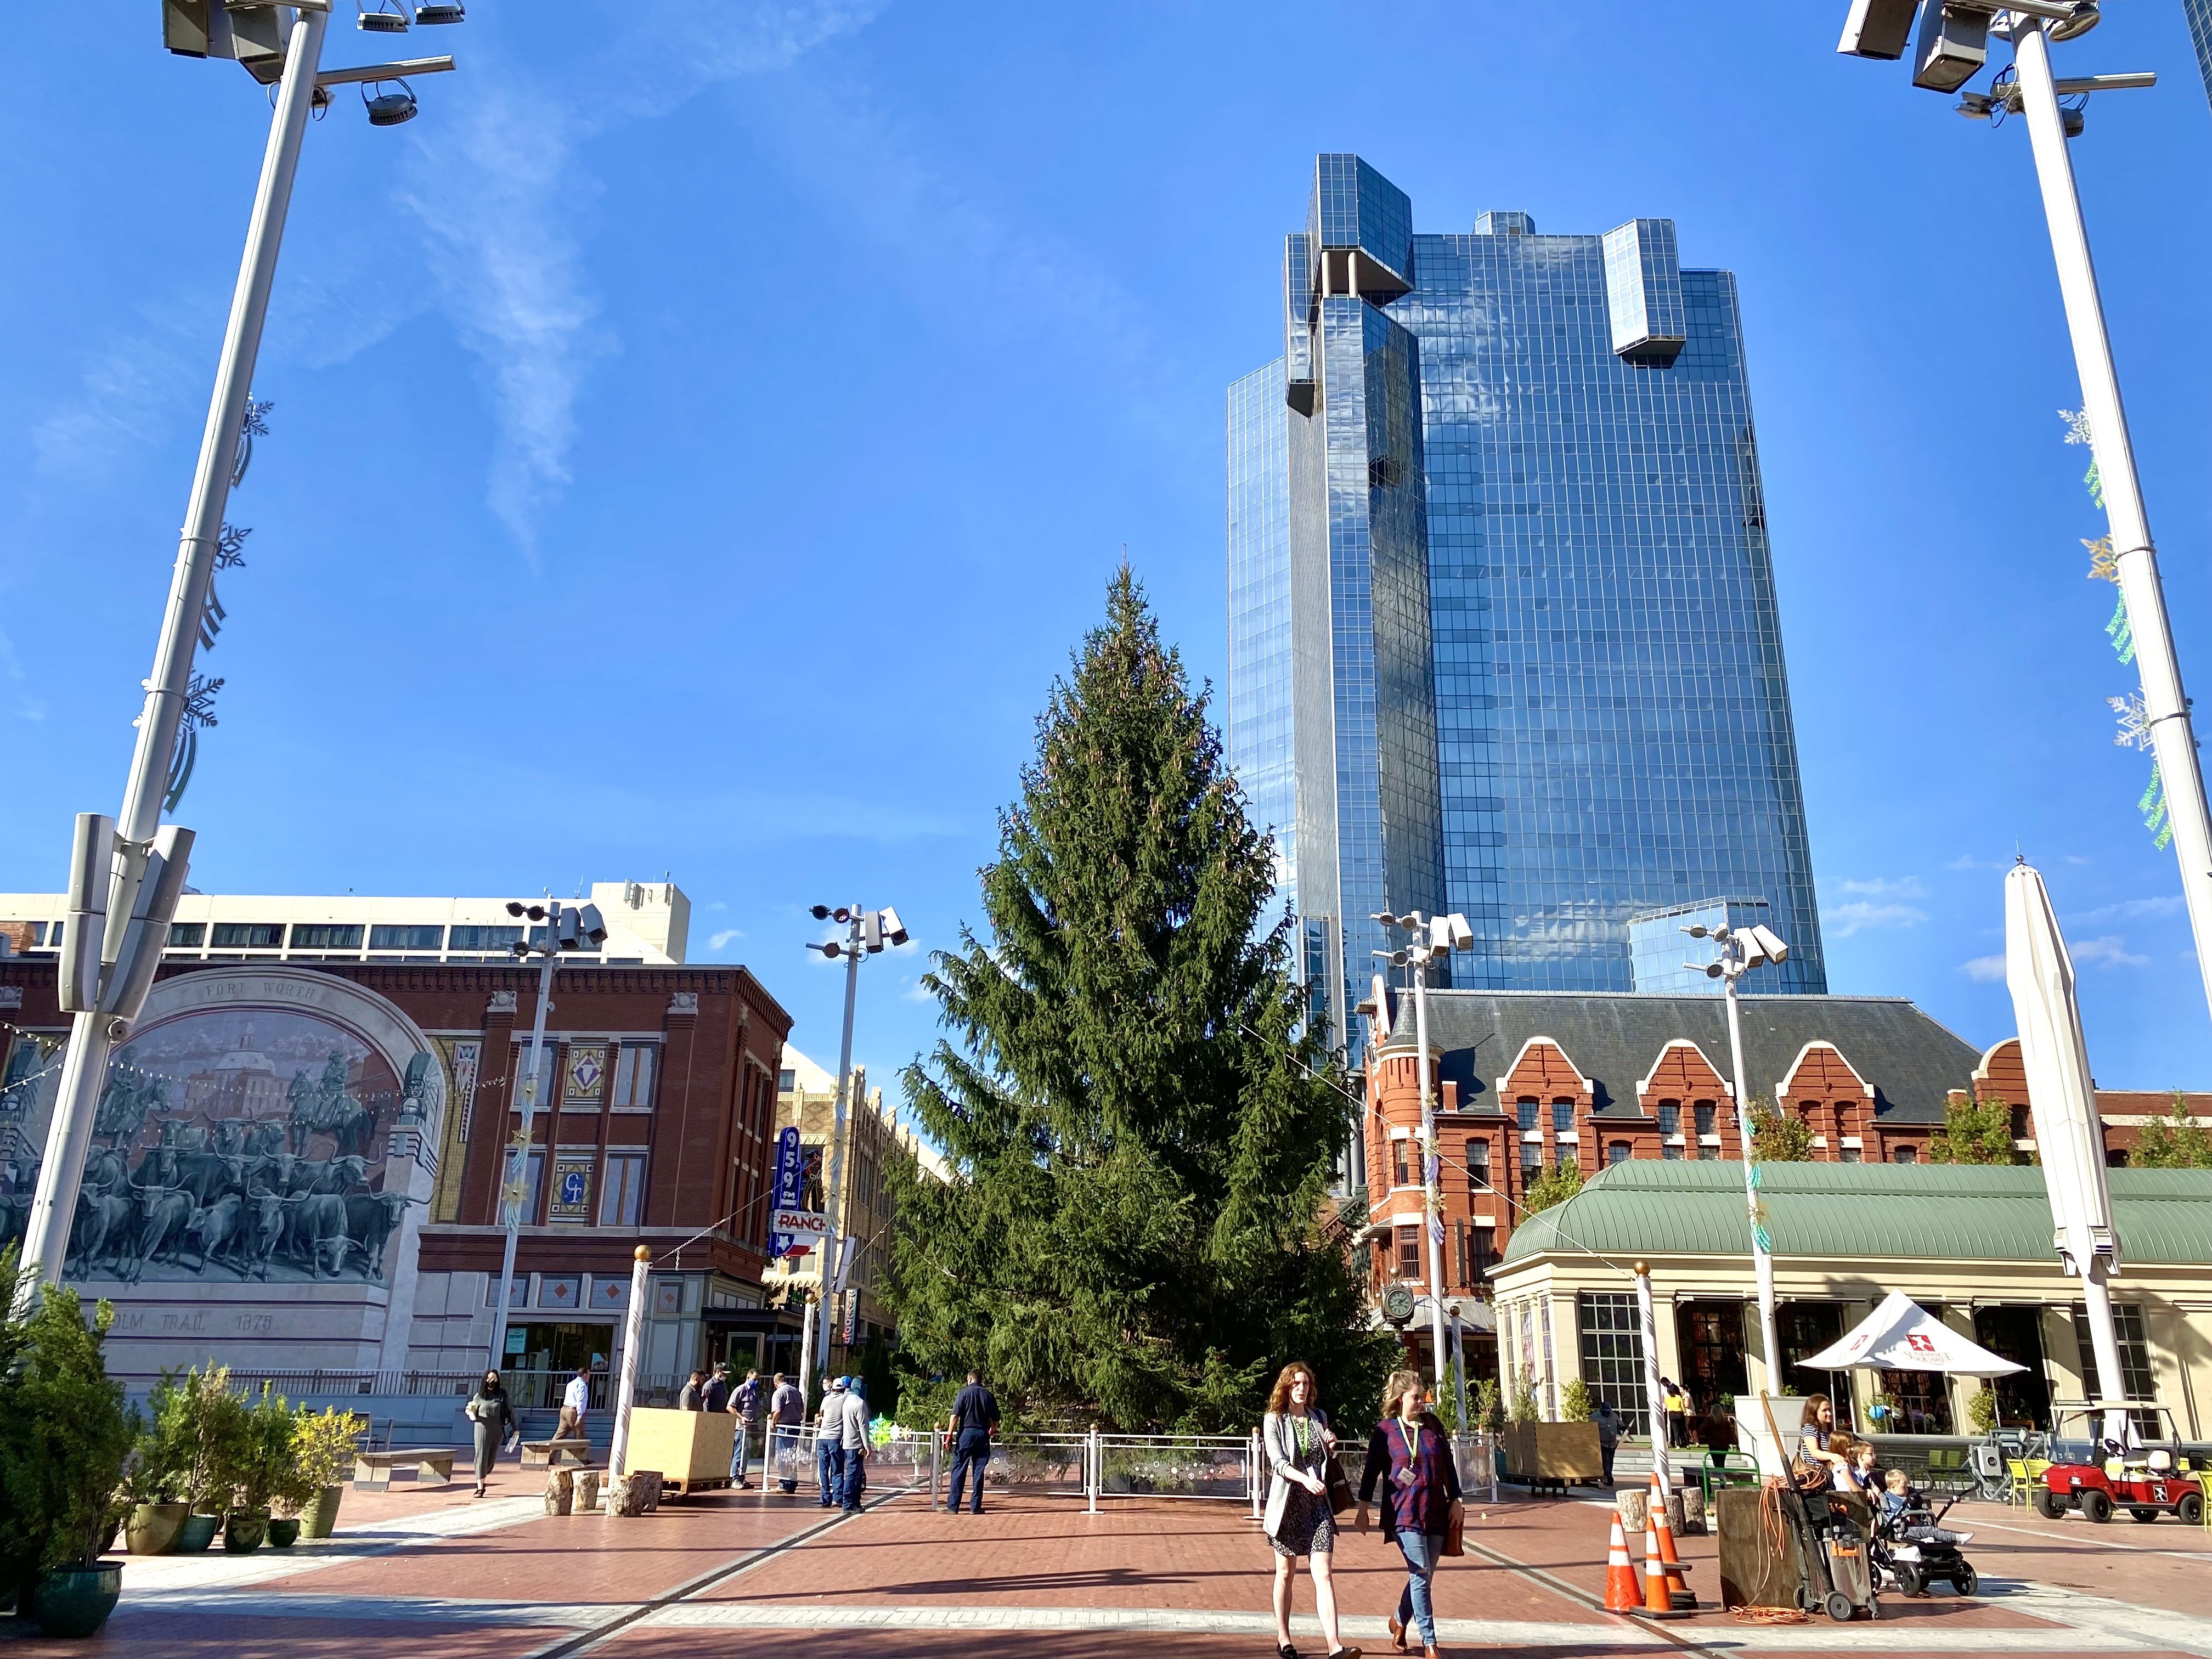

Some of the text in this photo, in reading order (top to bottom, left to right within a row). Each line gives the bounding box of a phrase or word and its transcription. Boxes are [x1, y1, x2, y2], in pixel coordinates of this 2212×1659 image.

[206, 982, 315, 1000] FORT WORTH
[783, 1191, 795, 1200] FM
[778, 1214, 827, 1232] RANCH
[162, 1314, 205, 1330] TRAIL
[236, 1314, 273, 1330] 1875
